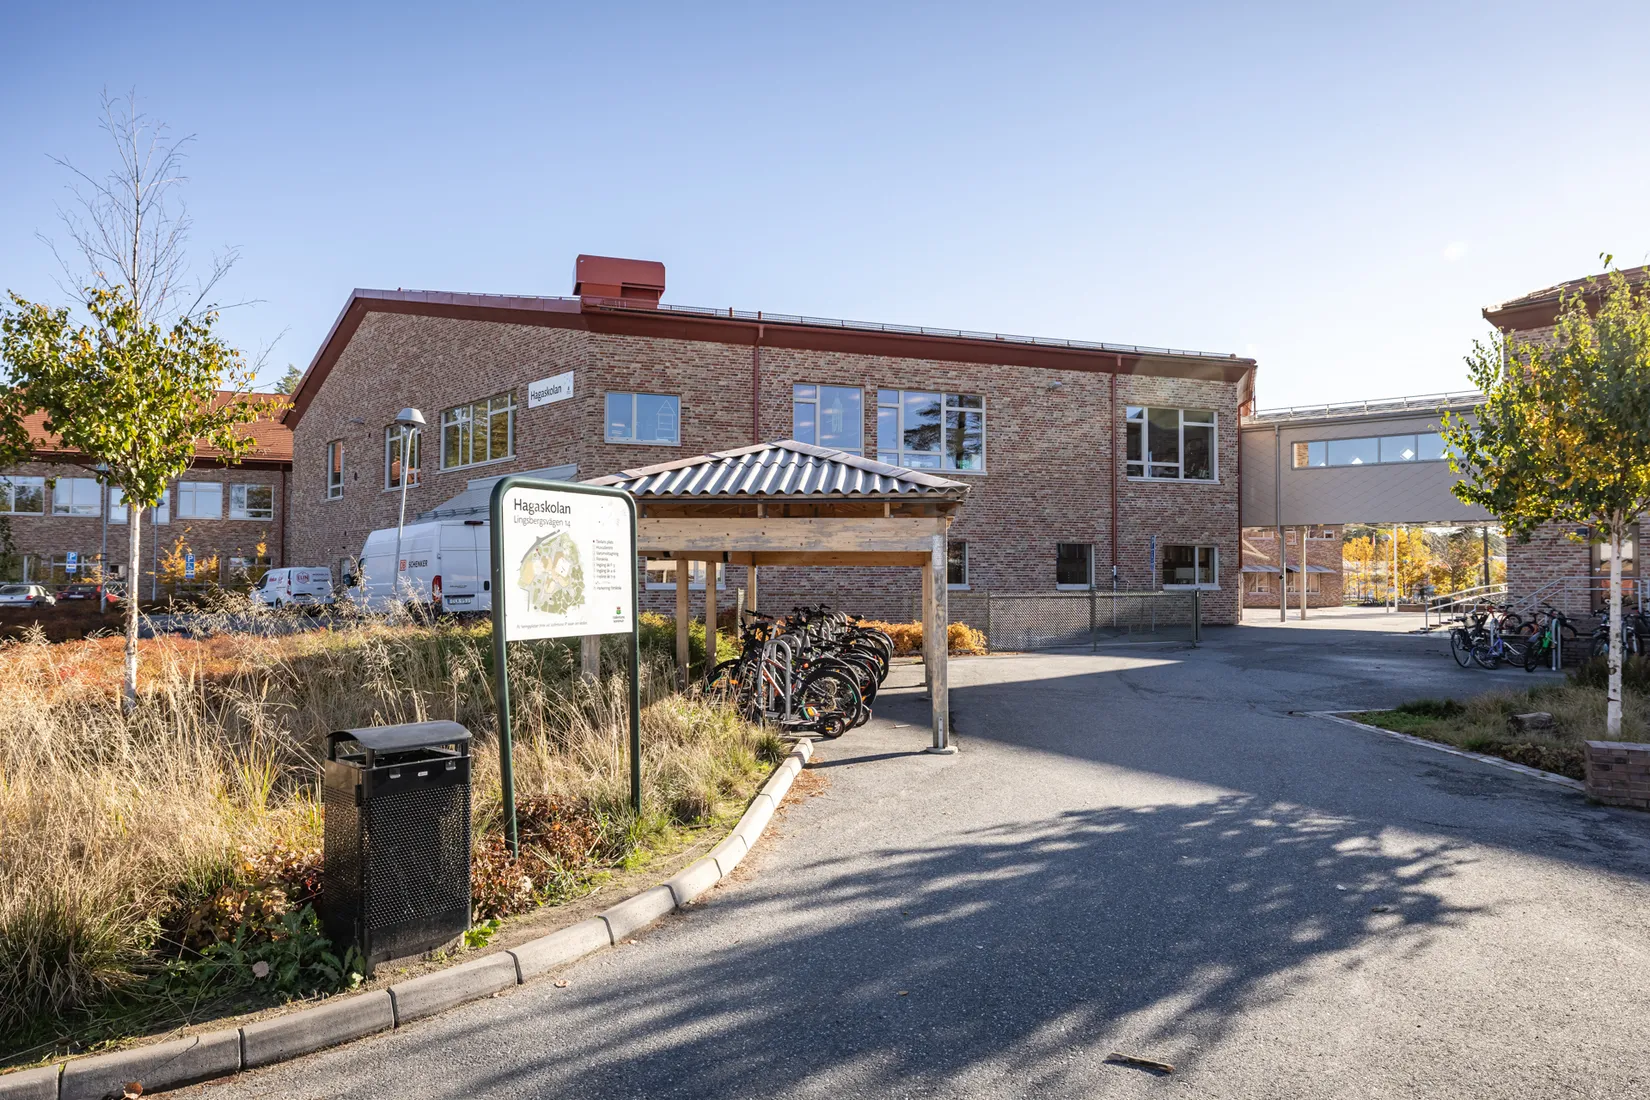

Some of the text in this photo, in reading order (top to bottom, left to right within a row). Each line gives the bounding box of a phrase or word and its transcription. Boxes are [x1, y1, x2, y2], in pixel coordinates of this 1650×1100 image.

[530, 384, 562, 402] Hagaskolan
[513, 498, 571, 516] Hagaskolan
[513, 515, 571, 529] Lingsbergsvägen 14
[408, 559, 428, 569] SCHENKER
